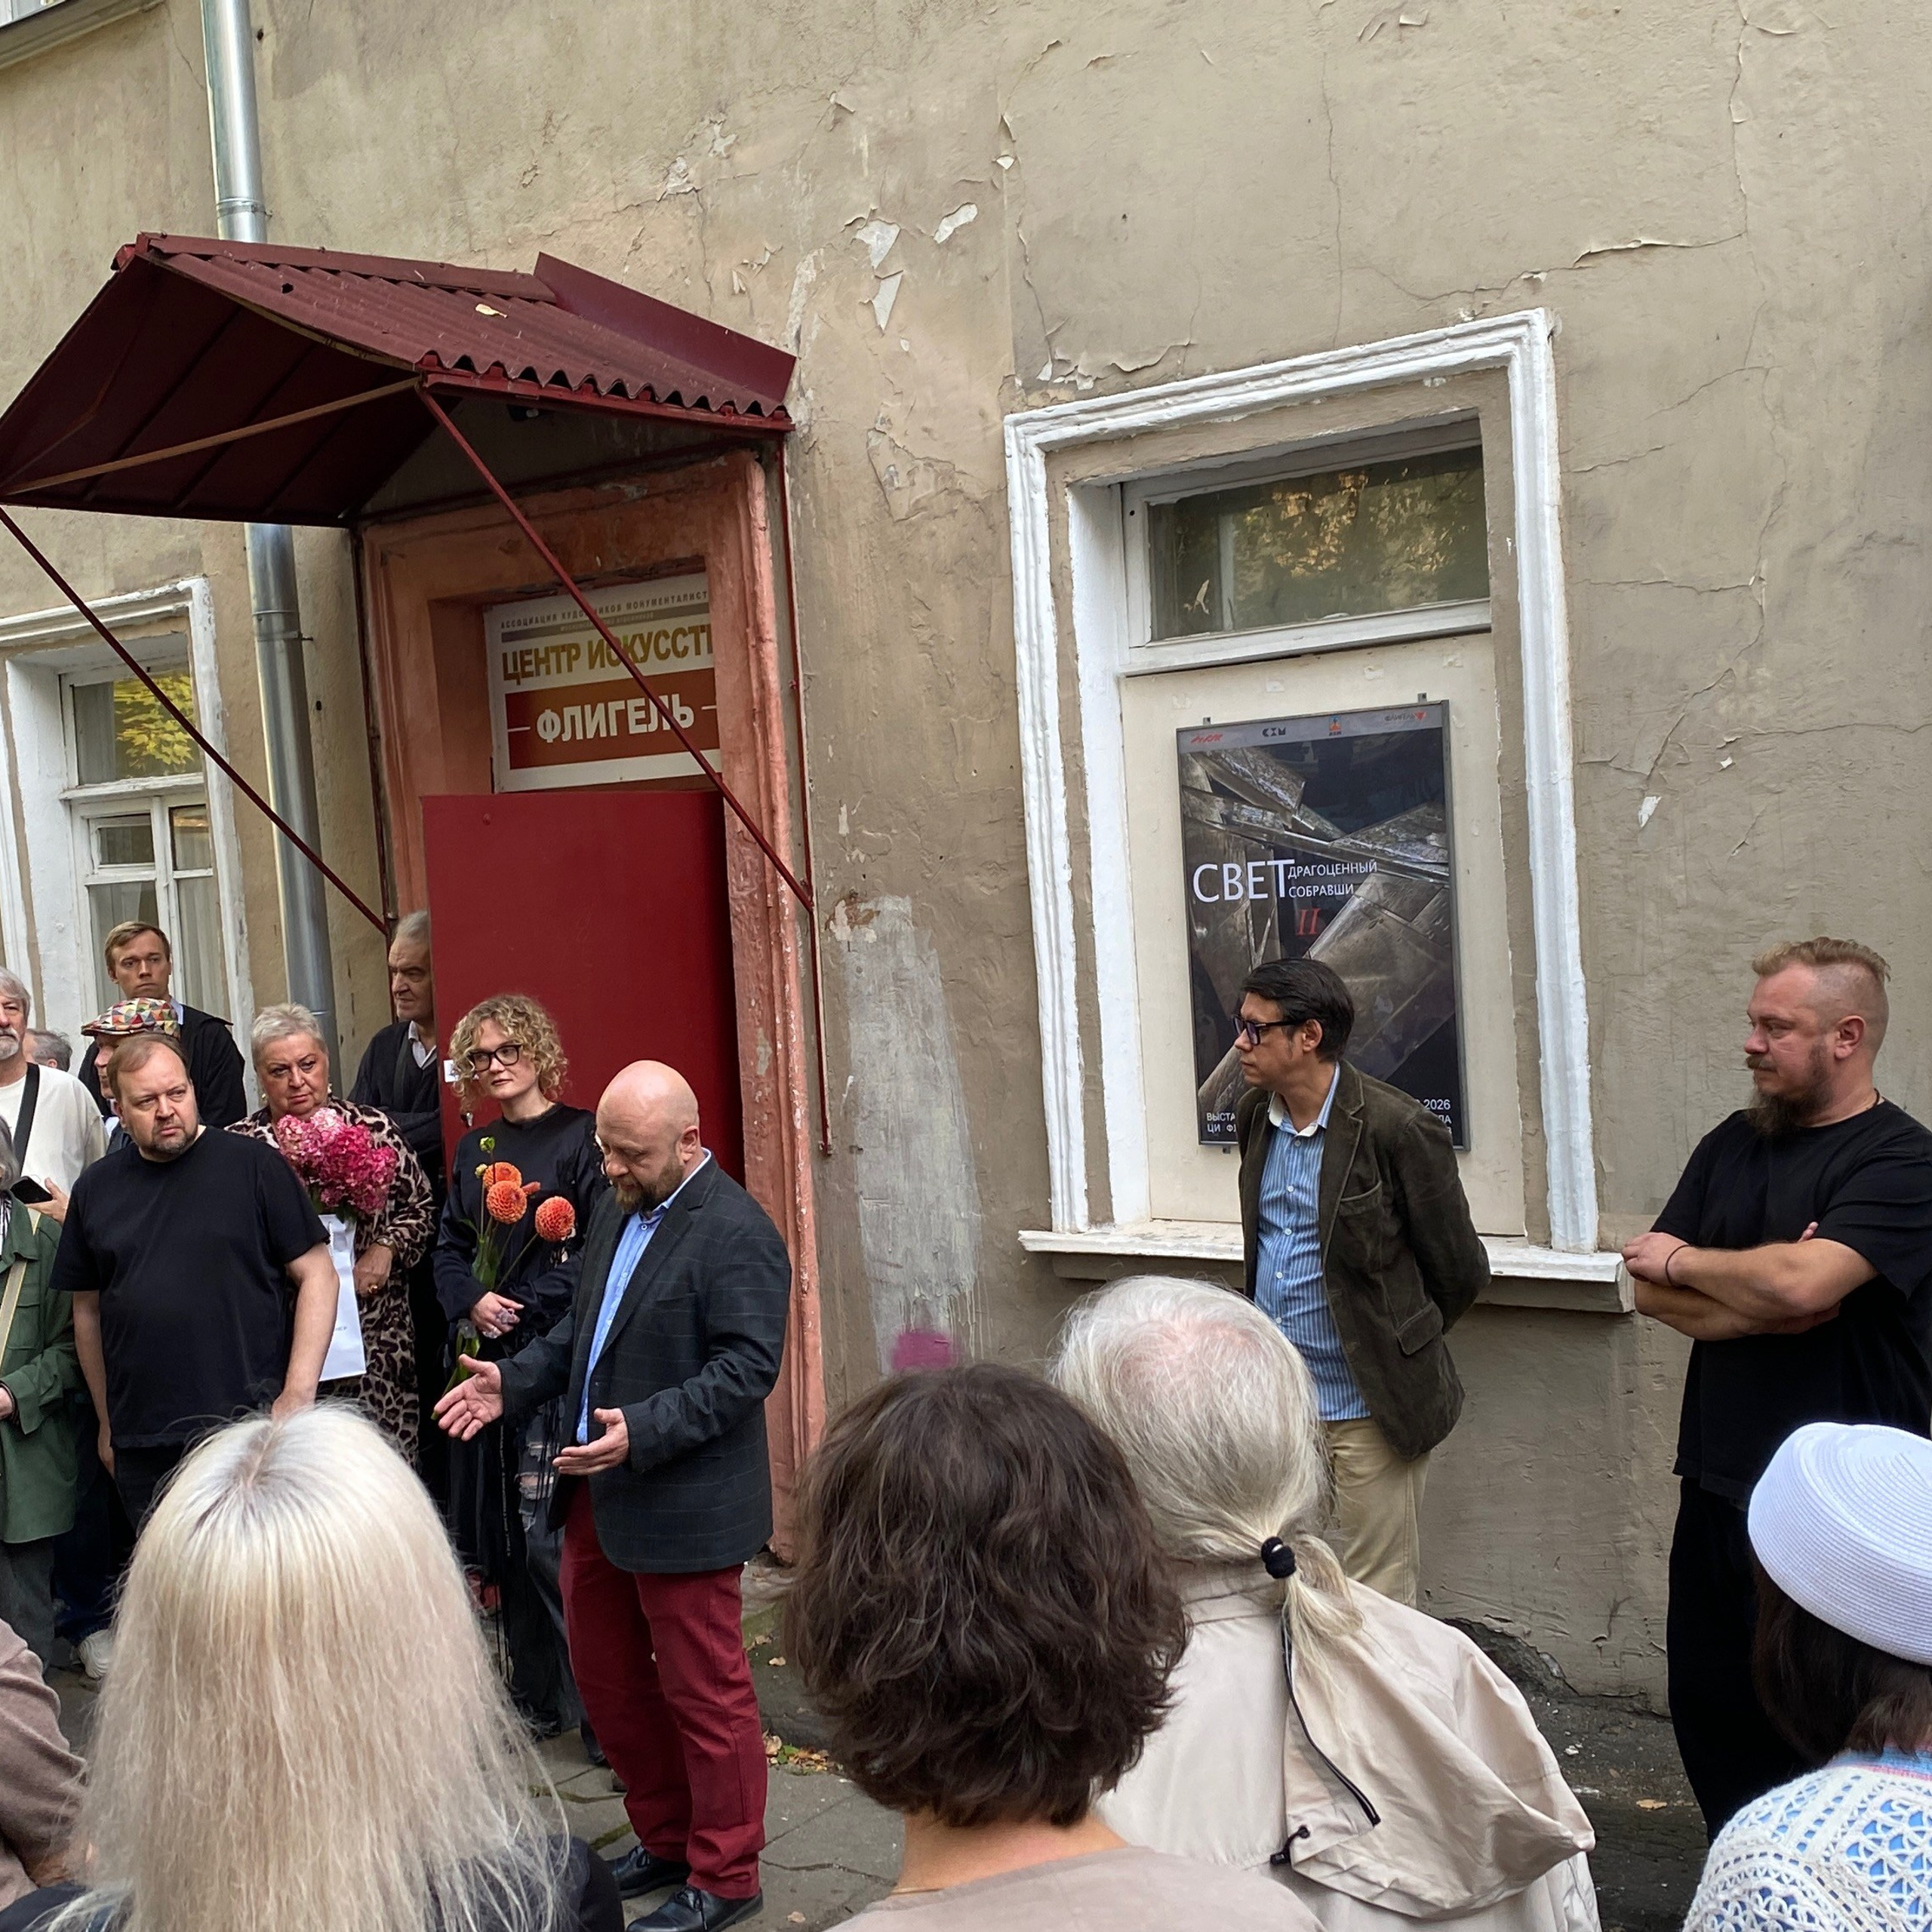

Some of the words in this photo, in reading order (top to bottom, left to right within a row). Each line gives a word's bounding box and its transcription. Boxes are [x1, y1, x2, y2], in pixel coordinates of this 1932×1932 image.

[500, 614, 557, 629] АССОЦИАЦИЯ
[561, 604, 621, 620] ХУДОИКОВ
[502, 643, 581, 685] ЦЕНТР
[537, 693, 694, 743] ФЛИГЕЛЬ
[1192, 859, 1295, 903] СВЕТ
[1287, 859, 1377, 879] ДРАГОЦЕННЫЙ
[1288, 884, 1354, 898] СОБРАВШИ
[1416, 1099, 1451, 1110] 2026
